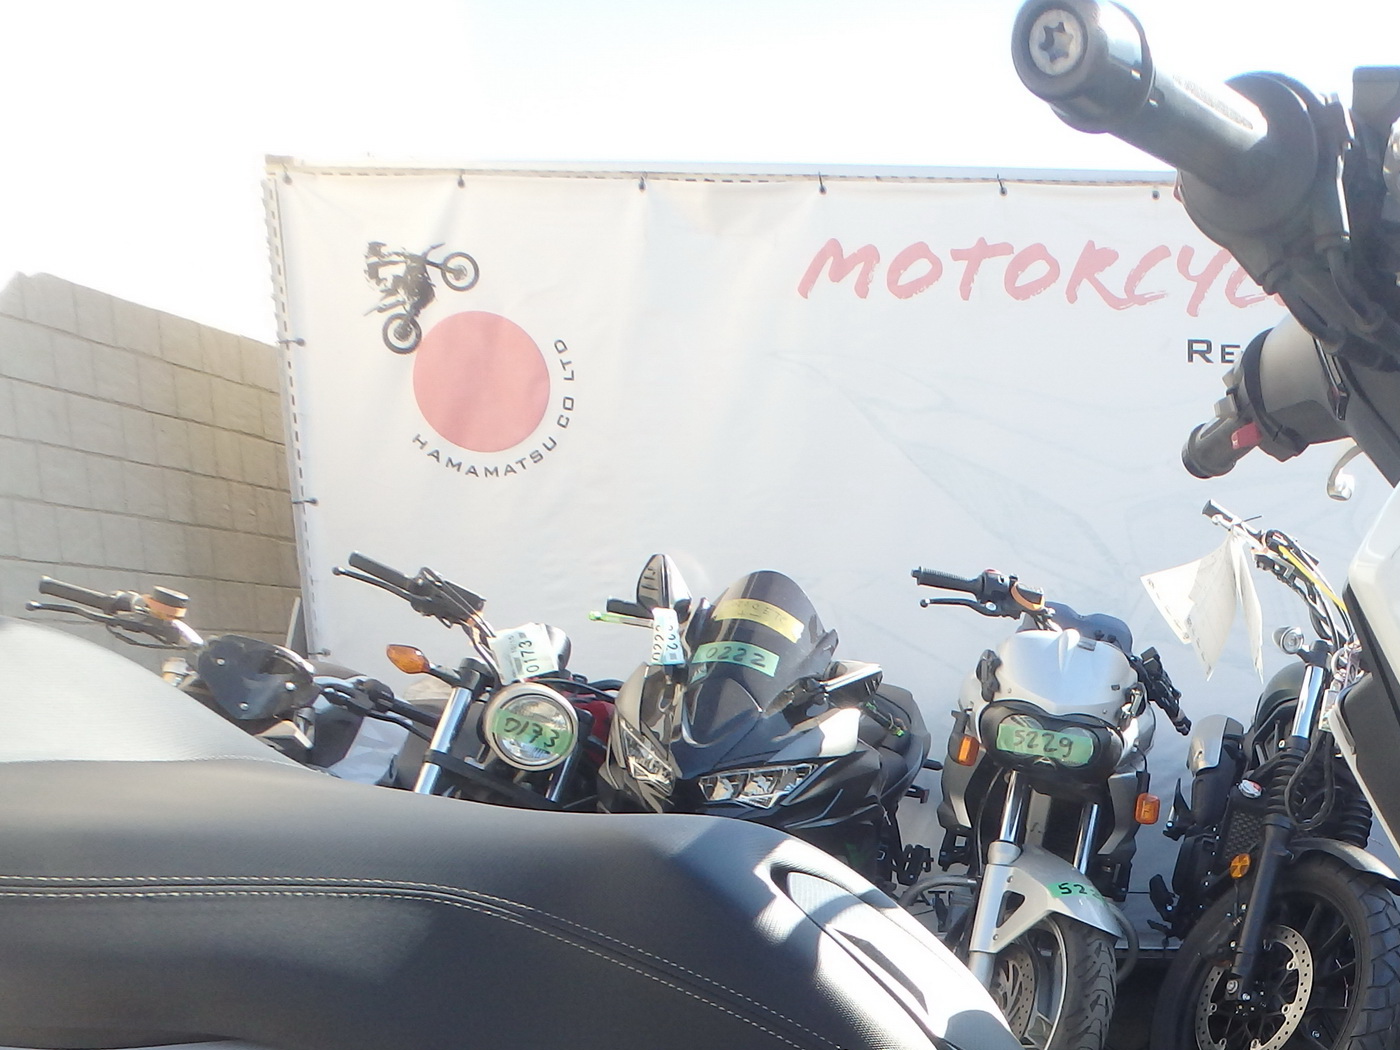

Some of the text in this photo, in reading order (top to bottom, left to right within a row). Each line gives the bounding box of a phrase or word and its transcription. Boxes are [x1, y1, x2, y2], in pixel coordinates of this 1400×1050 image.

[1187, 338, 1241, 364] RE
[412, 339, 575, 478] HAMAMATSU CO LTD
[518, 640, 540, 673] 0173
[706, 646, 766, 668] 0222
[503, 716, 560, 749] 0173
[1013, 729, 1075, 758] 5229
